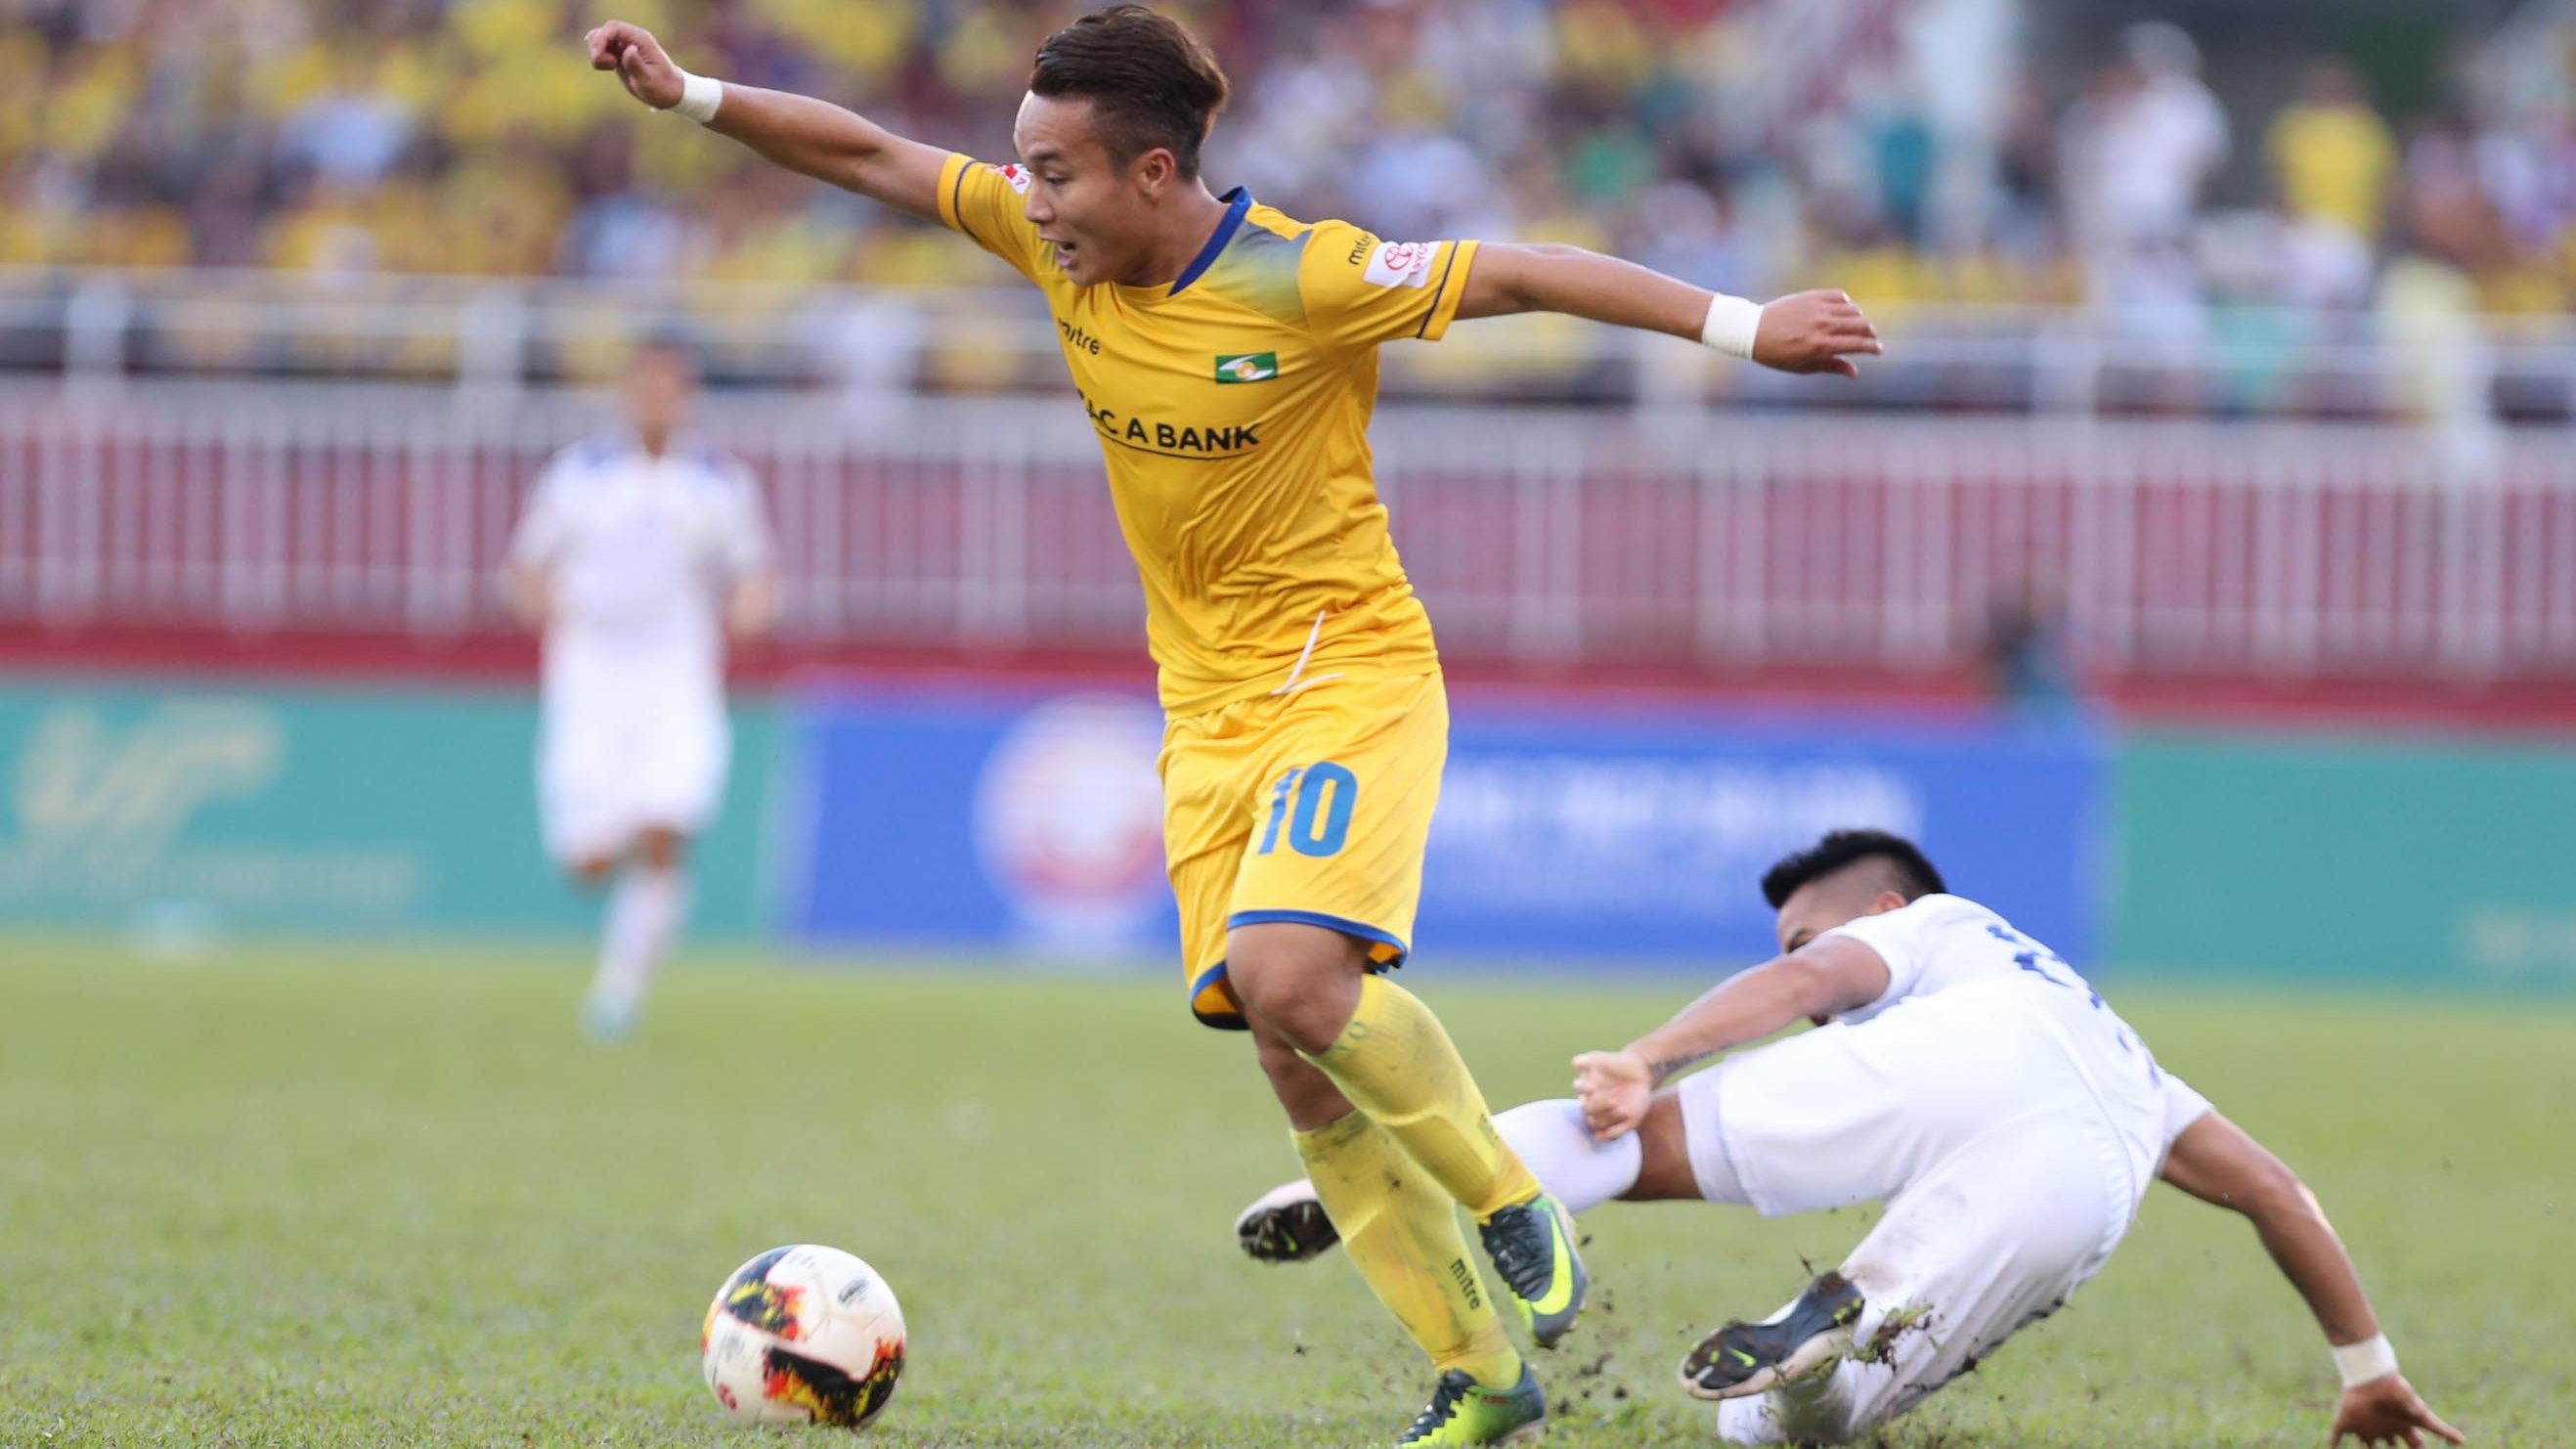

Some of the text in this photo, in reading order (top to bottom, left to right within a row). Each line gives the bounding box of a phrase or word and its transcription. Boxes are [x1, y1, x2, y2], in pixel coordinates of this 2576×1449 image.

[1126, 417, 1149, 444] A
[1157, 422, 1260, 452] BANK
[1258, 761, 1358, 857] 10
[1451, 1257, 1480, 1310] mitre
